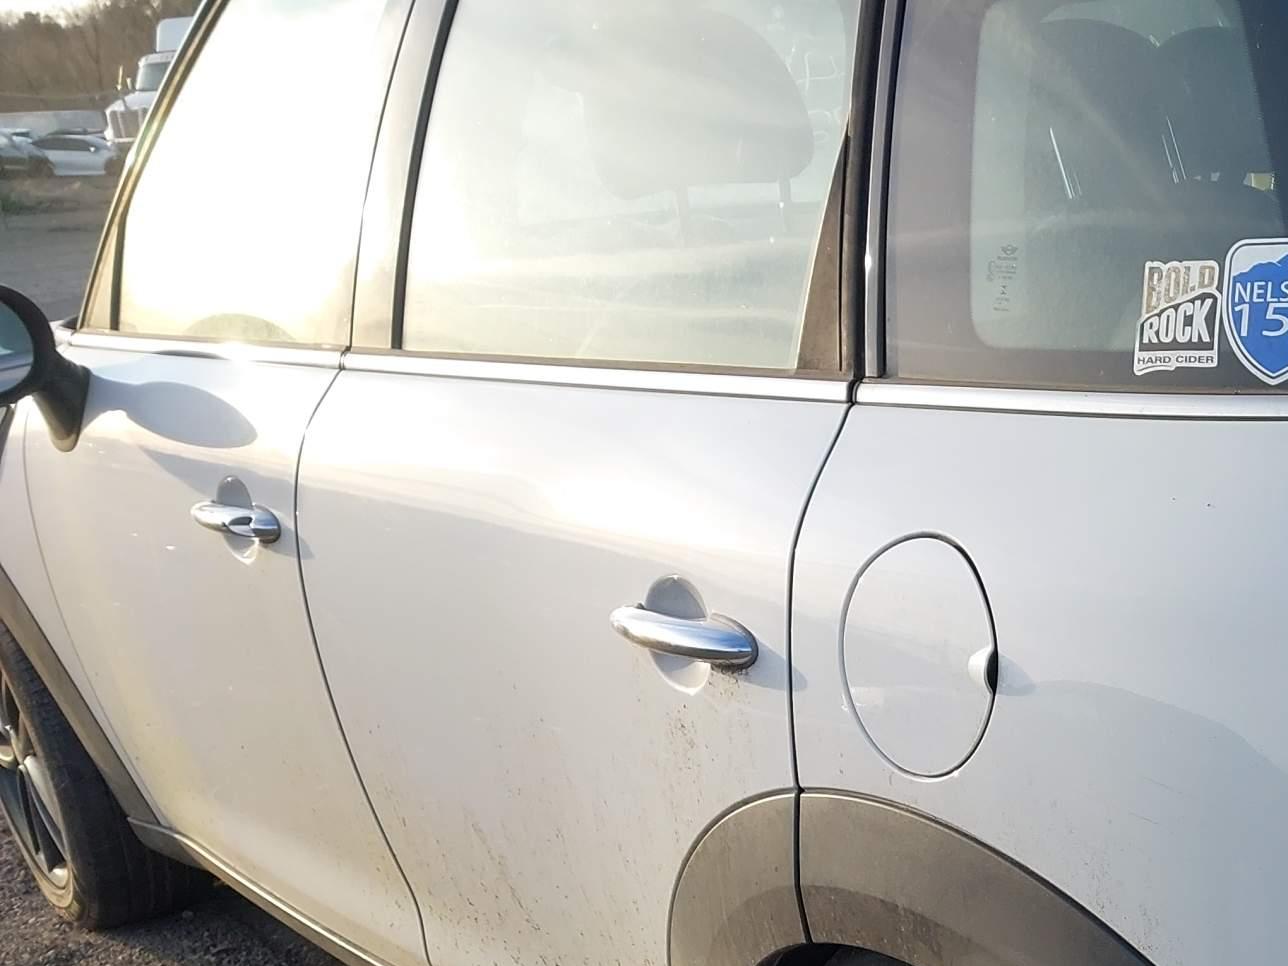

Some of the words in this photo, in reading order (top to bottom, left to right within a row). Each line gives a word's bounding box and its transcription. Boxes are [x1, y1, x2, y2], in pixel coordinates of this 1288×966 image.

[1143, 298, 1214, 344] ROCK
[1137, 355, 1172, 365] HARD
[1175, 355, 1214, 365] CIDER
